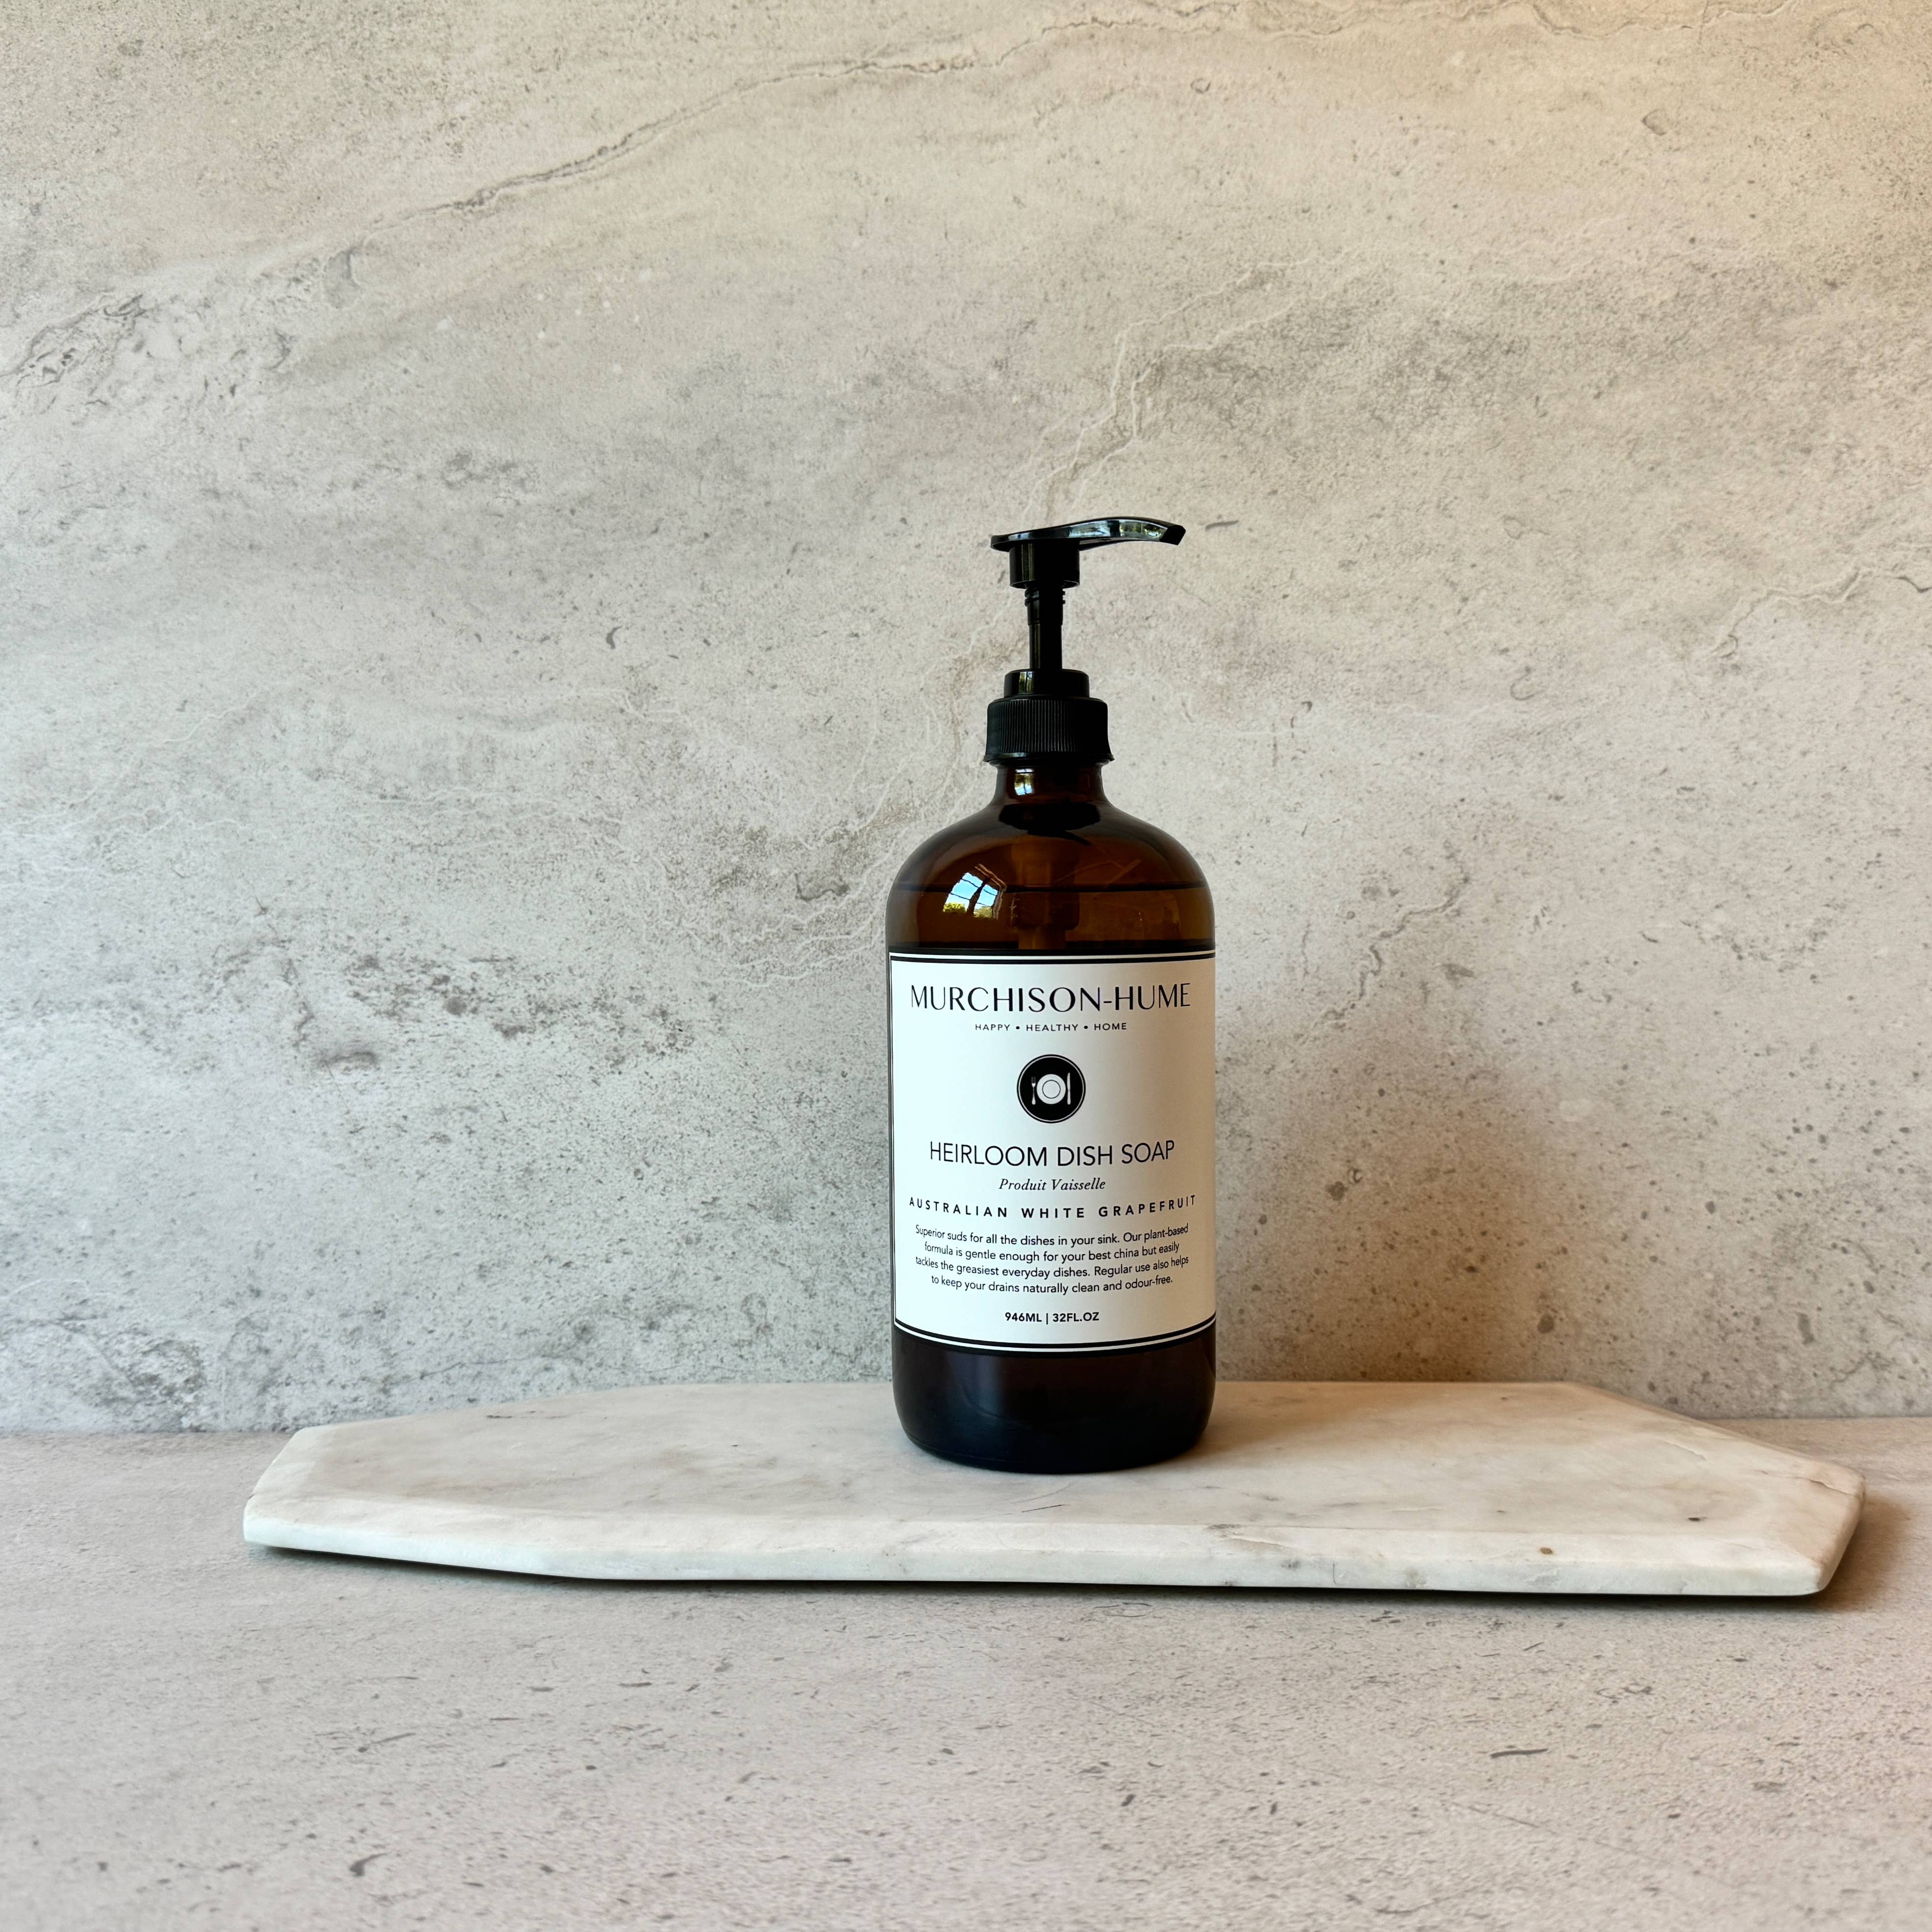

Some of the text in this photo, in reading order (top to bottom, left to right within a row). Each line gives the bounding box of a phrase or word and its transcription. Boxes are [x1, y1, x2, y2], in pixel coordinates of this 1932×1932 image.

[911, 982, 1191, 1013] MURCHISON-HUME
[975, 1022, 1127, 1032] HAPPY HEALTHY HOME
[930, 1140, 1175, 1167] HEIRLOOM DISH SOAP
[998, 1177, 1106, 1191] Produit Vaisselle
[909, 1194, 1196, 1219] AUSTRALIAN WHITE GRAPEFRUIT
[915, 1222, 1189, 1249] Superior suds for all the dishes in your sink. Our plant-based
[924, 1240, 1179, 1264] formula is gentle enough for your best china but easily
[915, 1255, 1189, 1280] tackles the greasiest everyday dishes. Regular use also helps
[931, 1274, 1173, 1296] to keep your drains naturally clean and odour-free.
[1004, 1311, 1100, 1323] 946ML 32FL.OZ
